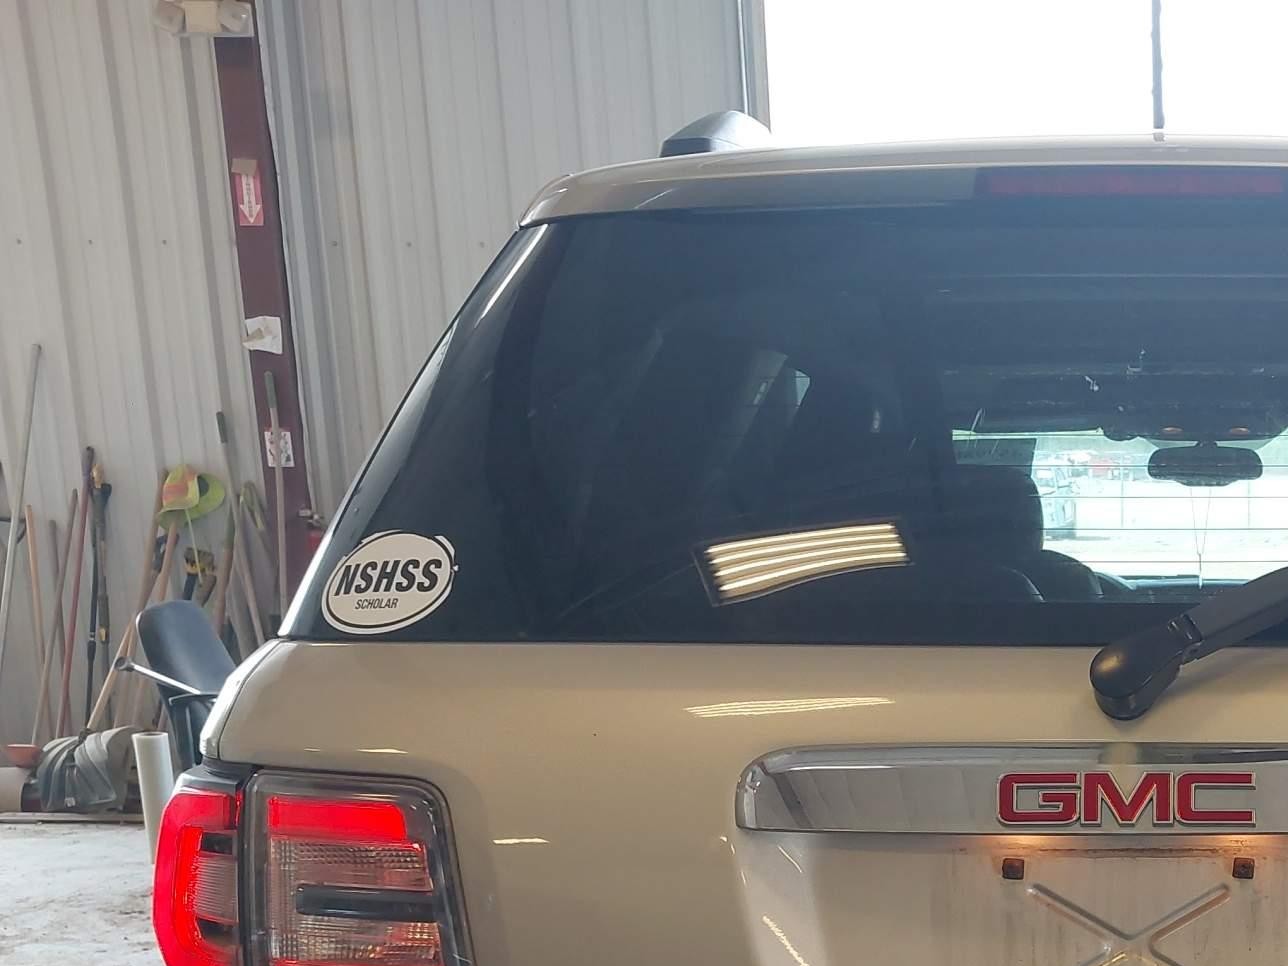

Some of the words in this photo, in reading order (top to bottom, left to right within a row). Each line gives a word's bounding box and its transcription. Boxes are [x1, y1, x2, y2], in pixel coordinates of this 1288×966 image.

[333, 558, 443, 596] NSHSS
[354, 598, 399, 610] SCHOLAR
[996, 771, 1257, 827] GMC
